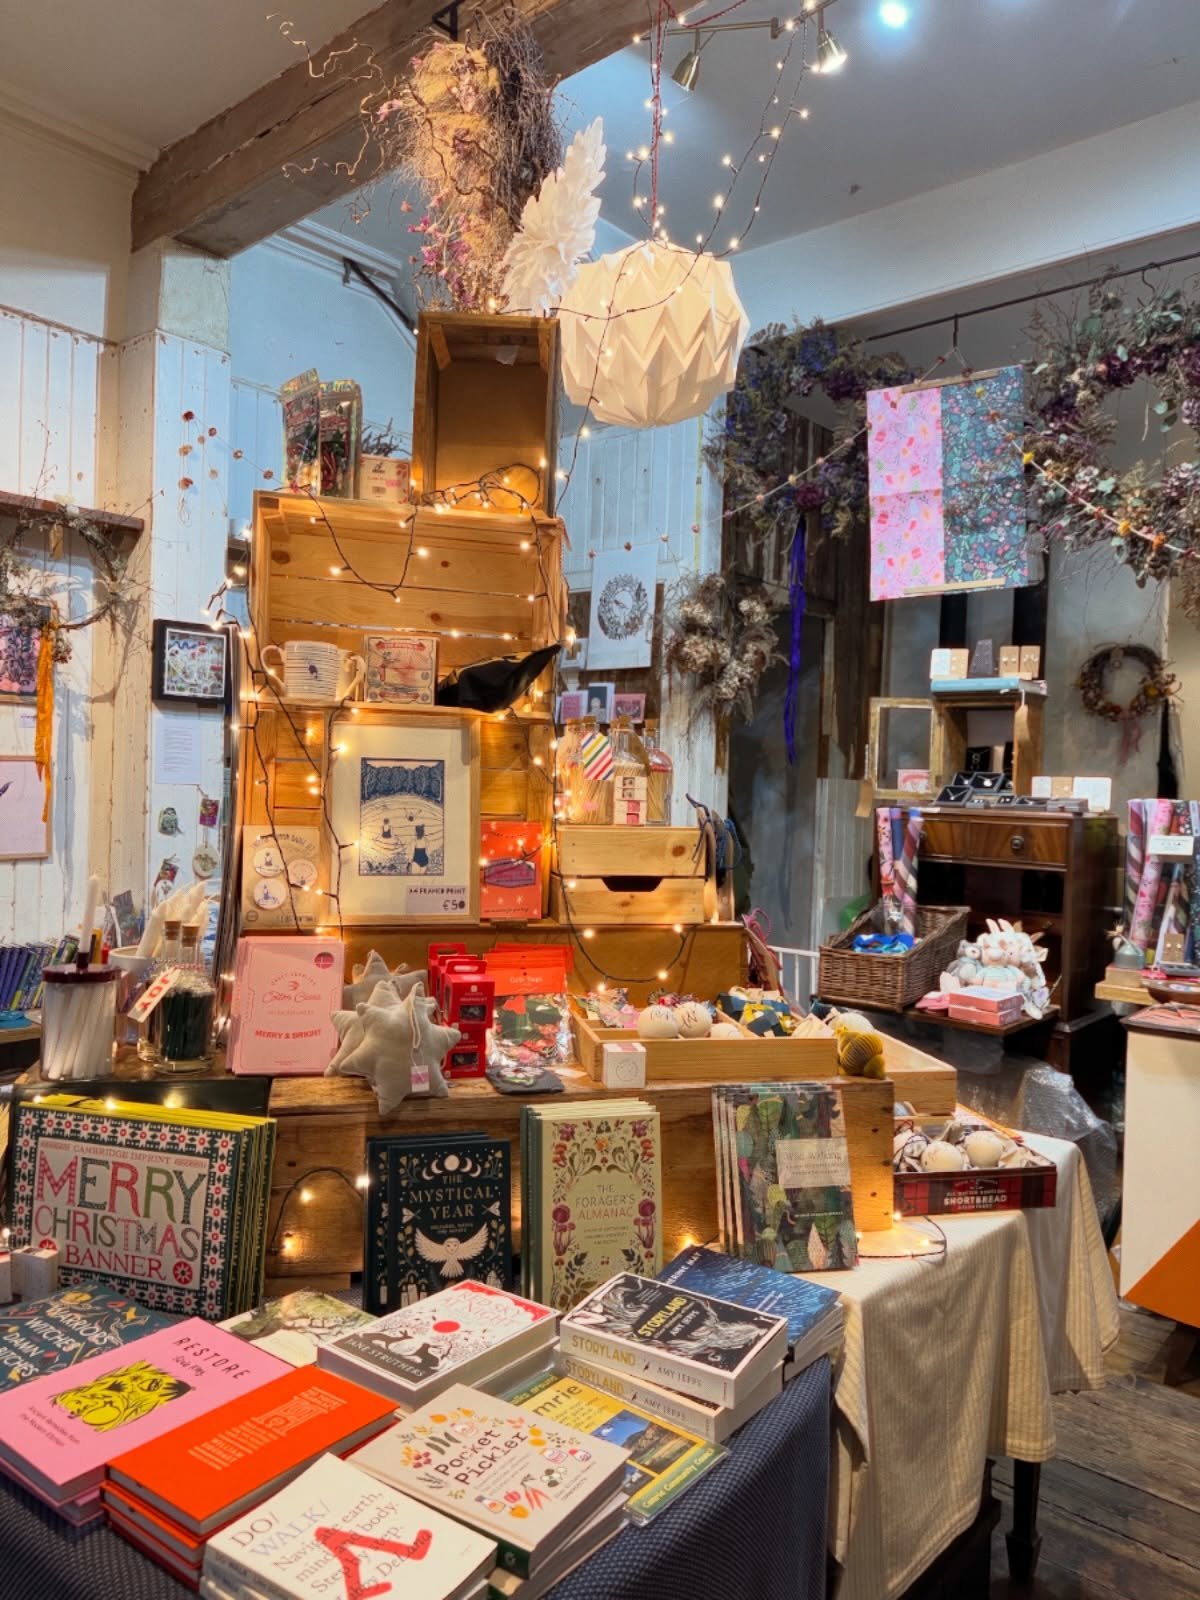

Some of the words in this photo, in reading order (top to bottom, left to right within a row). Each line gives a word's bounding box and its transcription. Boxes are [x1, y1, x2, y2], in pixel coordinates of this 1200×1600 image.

[420, 887, 445, 895] FRAMED
[446, 887, 466, 895] PRINT
[255, 1030, 283, 1039] MERRY
[291, 1028, 321, 1039] BRIGHT
[72, 1143, 129, 1161] CAMBRIDGE
[130, 1152, 170, 1165] IMPRINT
[36, 1150, 207, 1225] MERRY
[408, 1186, 494, 1204] MYSTICAL
[442, 1175, 464, 1185] THE
[596, 1184, 616, 1193] THE
[430, 1204, 476, 1220] YEAR
[575, 1193, 636, 1209] FORAGER'S
[578, 1206, 634, 1220] ALMANAC
[943, 1194, 1008, 1206] SHORTBREAD
[34, 1204, 202, 1262] CHRISTMAS
[64, 1244, 168, 1281] BANNER
[638, 1296, 688, 1338] STORYLAND
[3, 1332, 44, 1357] DAMN
[25, 1317, 82, 1353] WITCHES
[173, 1336, 251, 1380] RESTORE
[370, 1349, 424, 1378] STRUTHERS
[571, 1335, 636, 1366] STORYLAND
[565, 1359, 625, 1395] STORYLAND
[533, 1384, 584, 1417] mrie
[434, 1429, 502, 1478] Pocket
[454, 1431, 529, 1486] Pickler
[296, 1548, 335, 1583] mind
[311, 1563, 353, 1593] Step
